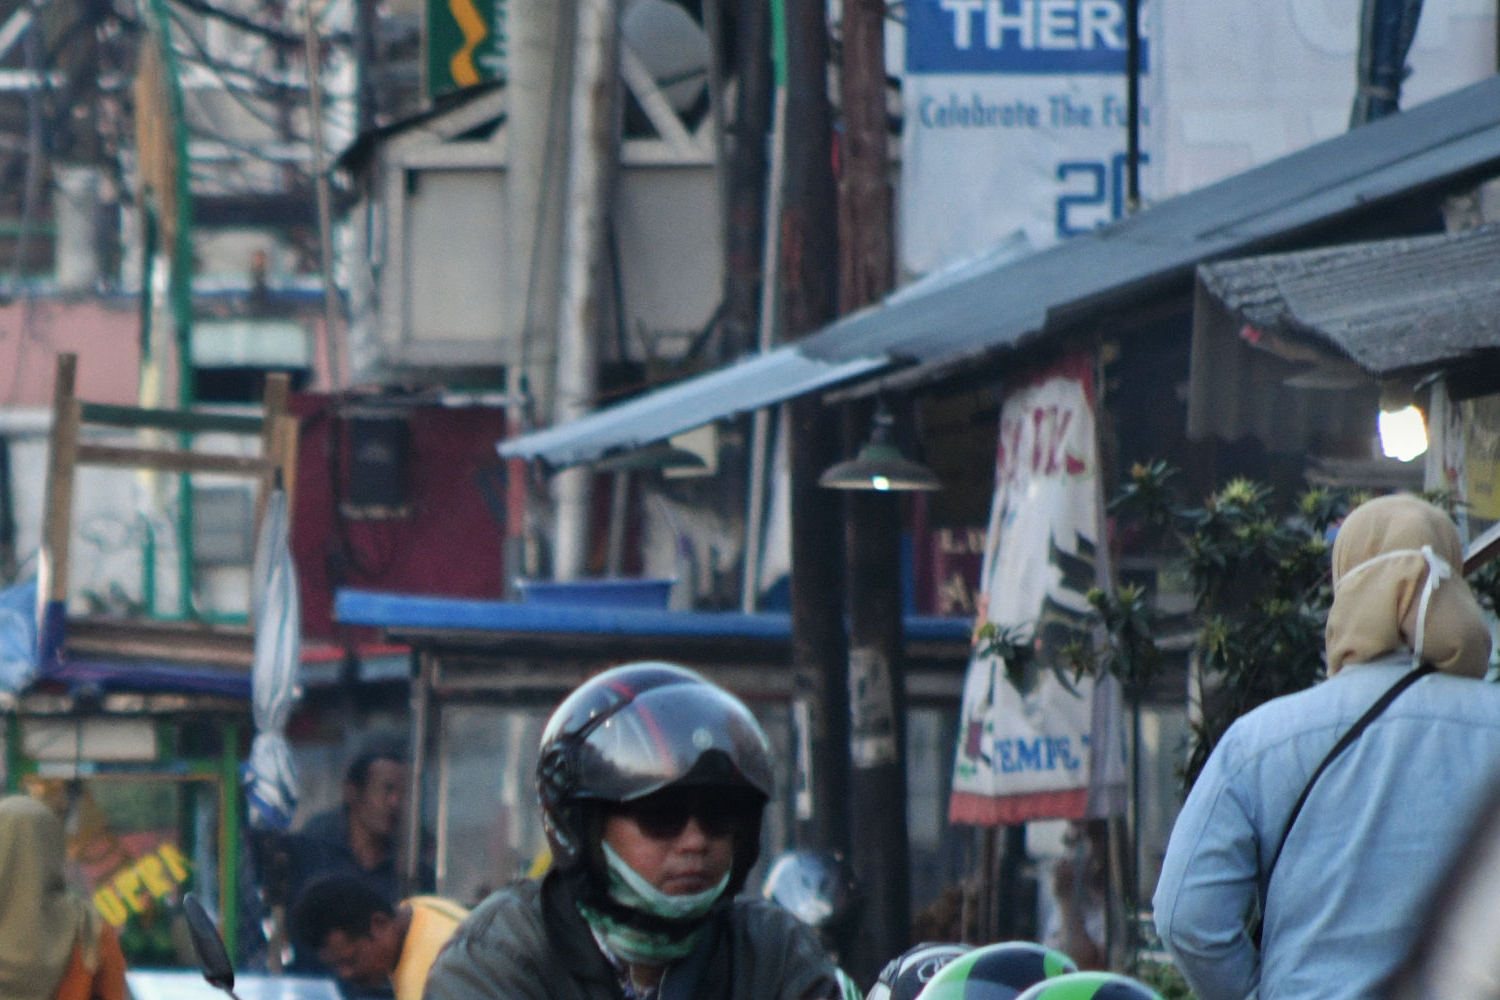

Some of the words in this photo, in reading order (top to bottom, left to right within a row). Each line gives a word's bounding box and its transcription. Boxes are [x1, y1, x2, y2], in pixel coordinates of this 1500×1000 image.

[940, 0, 1149, 50] THER
[920, 92, 1040, 128] Celebrate
[1049, 94, 1093, 127] The
